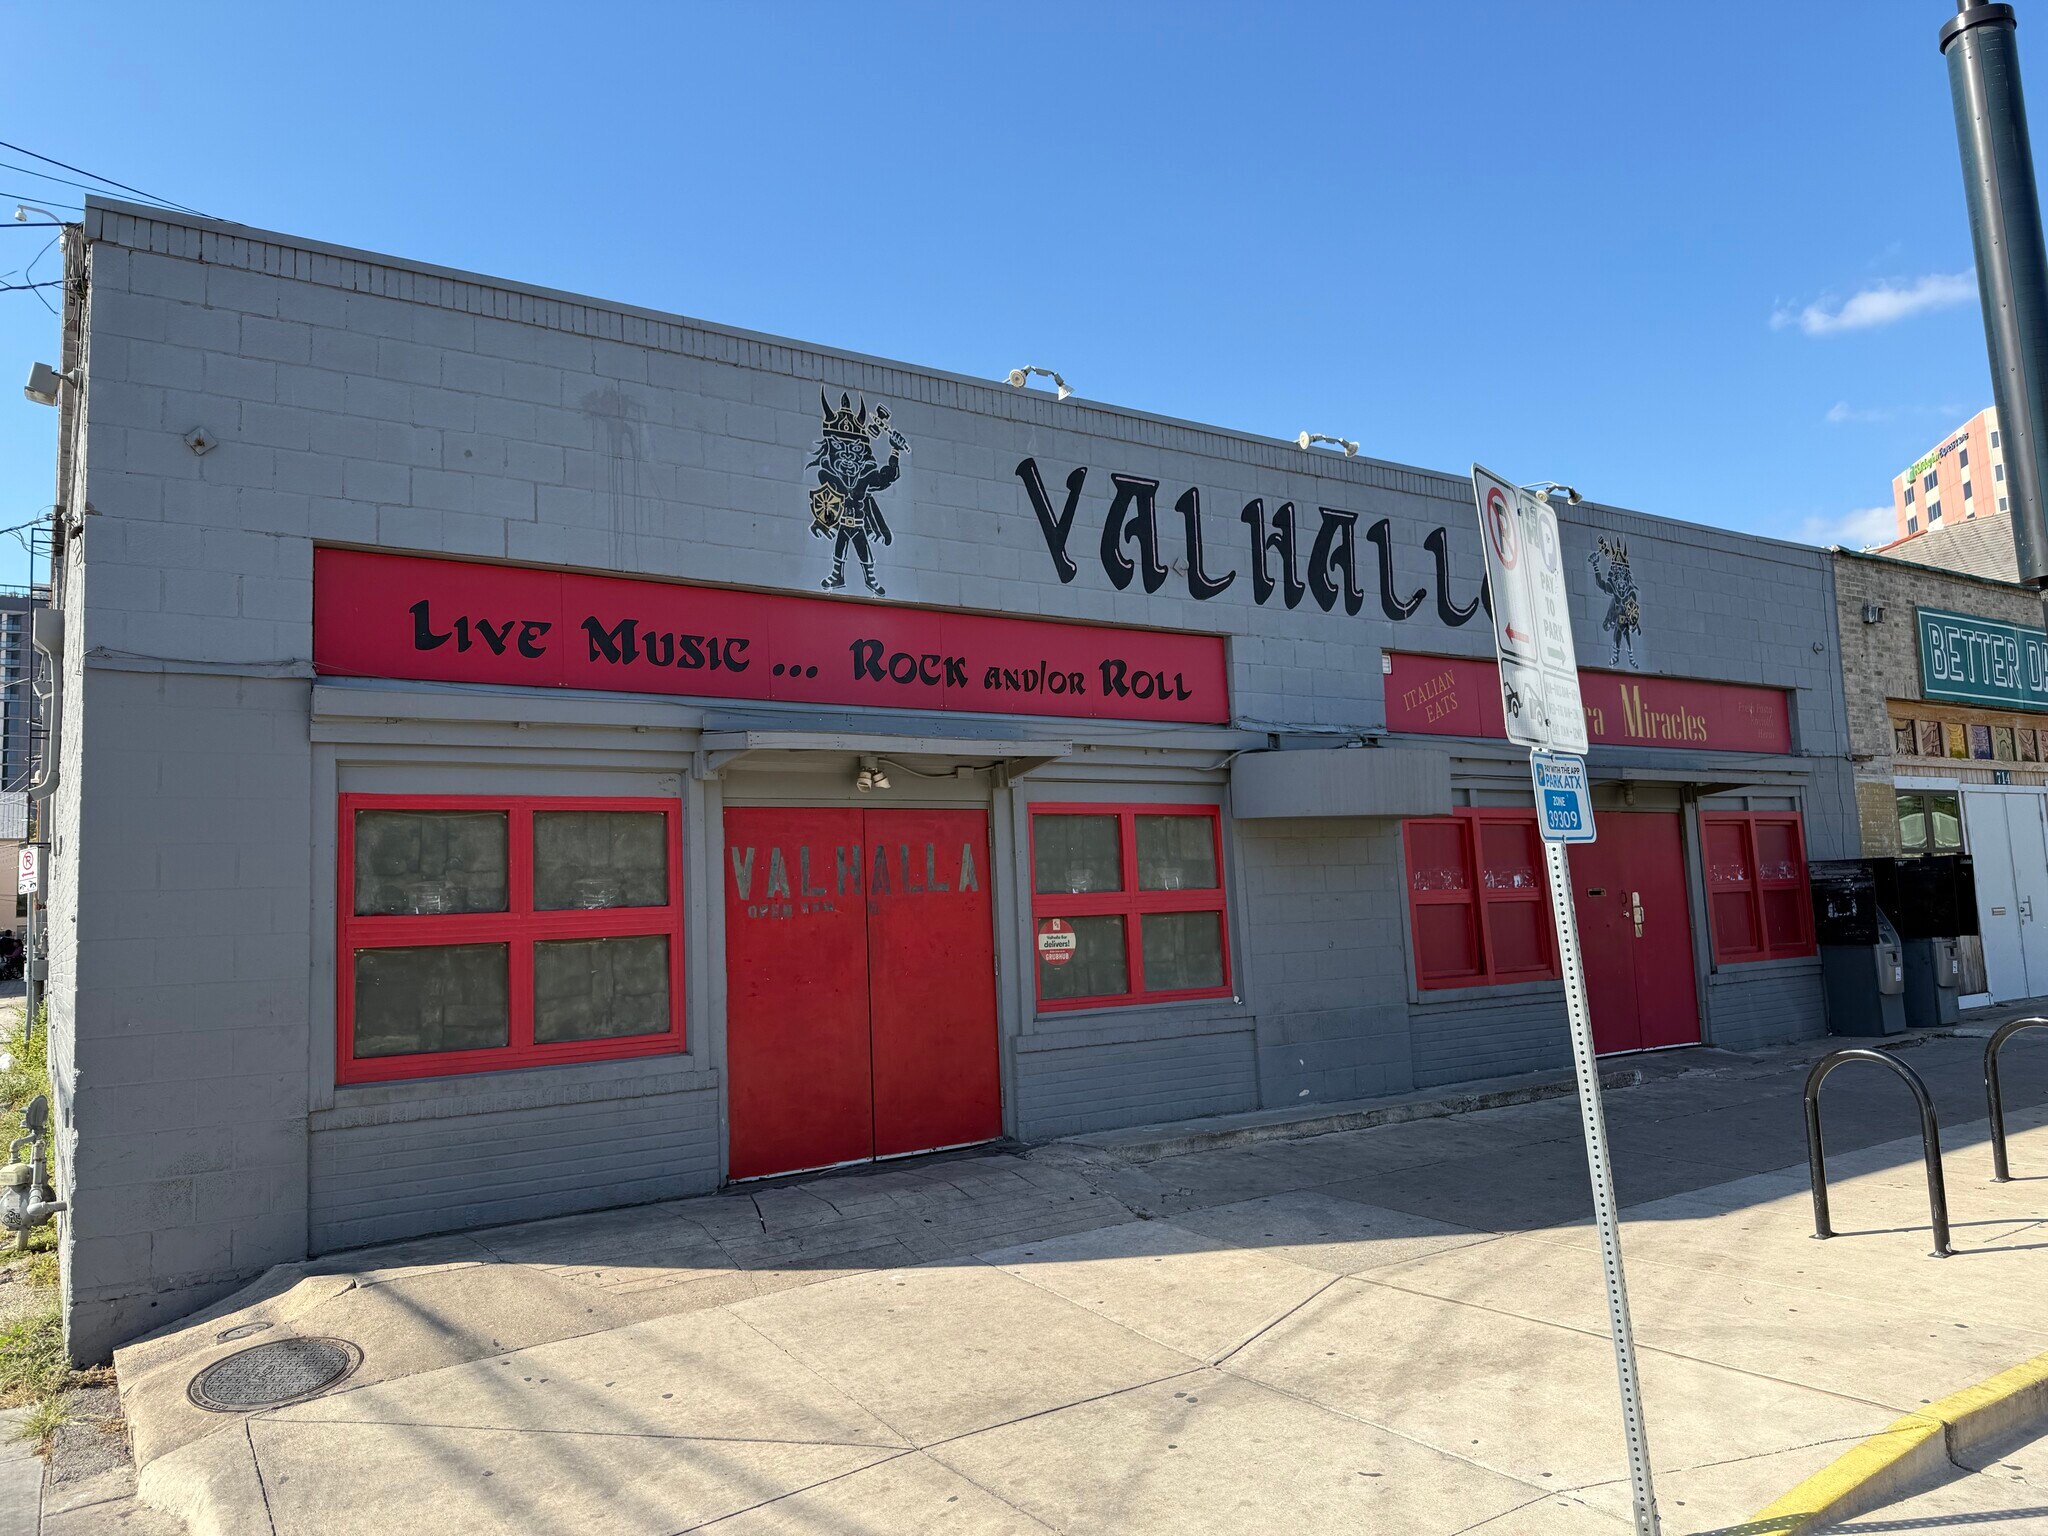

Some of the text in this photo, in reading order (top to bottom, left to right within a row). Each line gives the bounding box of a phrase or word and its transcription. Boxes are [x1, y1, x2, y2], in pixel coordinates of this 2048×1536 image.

[1015, 457, 1494, 627] VALHALL
[1540, 571, 1554, 594] PAY
[1545, 596, 1556, 617] TO
[1543, 619, 1564, 644] PARK
[1928, 622, 2023, 690] BETTER
[1403, 669, 1456, 712] ITALIAN
[1425, 692, 1458, 723] EATS
[1620, 683, 1707, 742] Miracles
[1545, 773, 1582, 789] PARK ATX
[1551, 766, 1560, 774] WITH
[1561, 766, 1570, 774] THE
[1996, 771, 2011, 785] 714
[1552, 796, 1566, 807] ZONE
[1548, 810, 1578, 828] 39309
[731, 843, 979, 900] VALHALLA
[1044, 940, 1070, 948] delivers!
